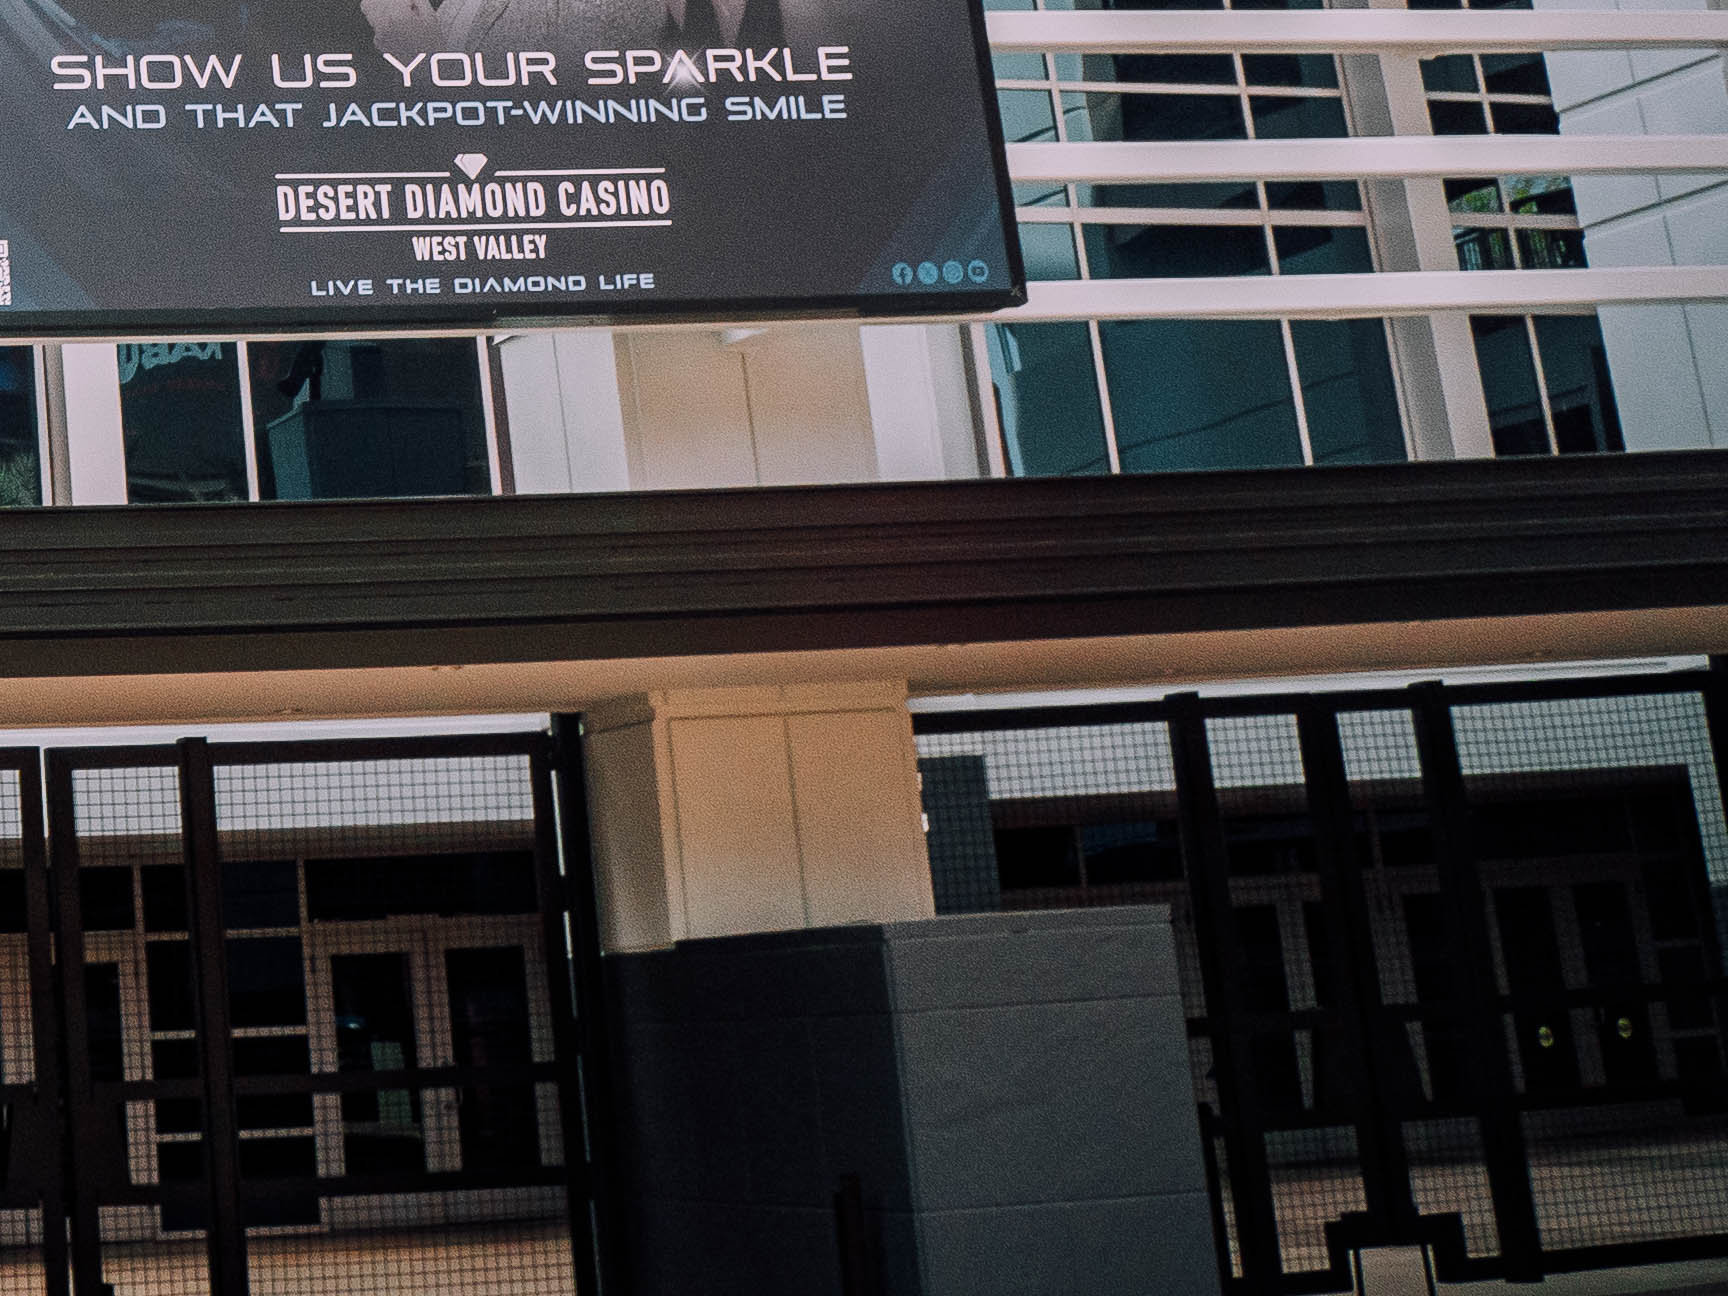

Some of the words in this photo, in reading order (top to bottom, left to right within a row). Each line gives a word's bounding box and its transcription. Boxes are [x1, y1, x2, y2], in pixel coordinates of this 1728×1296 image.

[50, 53, 243, 90] SHOW
[271, 53, 357, 89] US
[382, 51, 558, 87] YOUR
[584, 45, 853, 89] SPARKLE
[67, 104, 167, 130] AND
[184, 102, 304, 129] THAT
[322, 96, 708, 128] JACKPOT-WINNING
[725, 94, 848, 121] SMILE
[276, 183, 392, 222] DESERT
[404, 181, 546, 219] DIAMOND
[557, 179, 670, 217] CASINO
[411, 235, 468, 261] WEST
[472, 234, 547, 260] VALLEY
[310, 279, 374, 296] LIVE
[385, 278, 441, 295] THE
[453, 275, 587, 294] DIAMOND
[598, 273, 655, 290] LIFE
